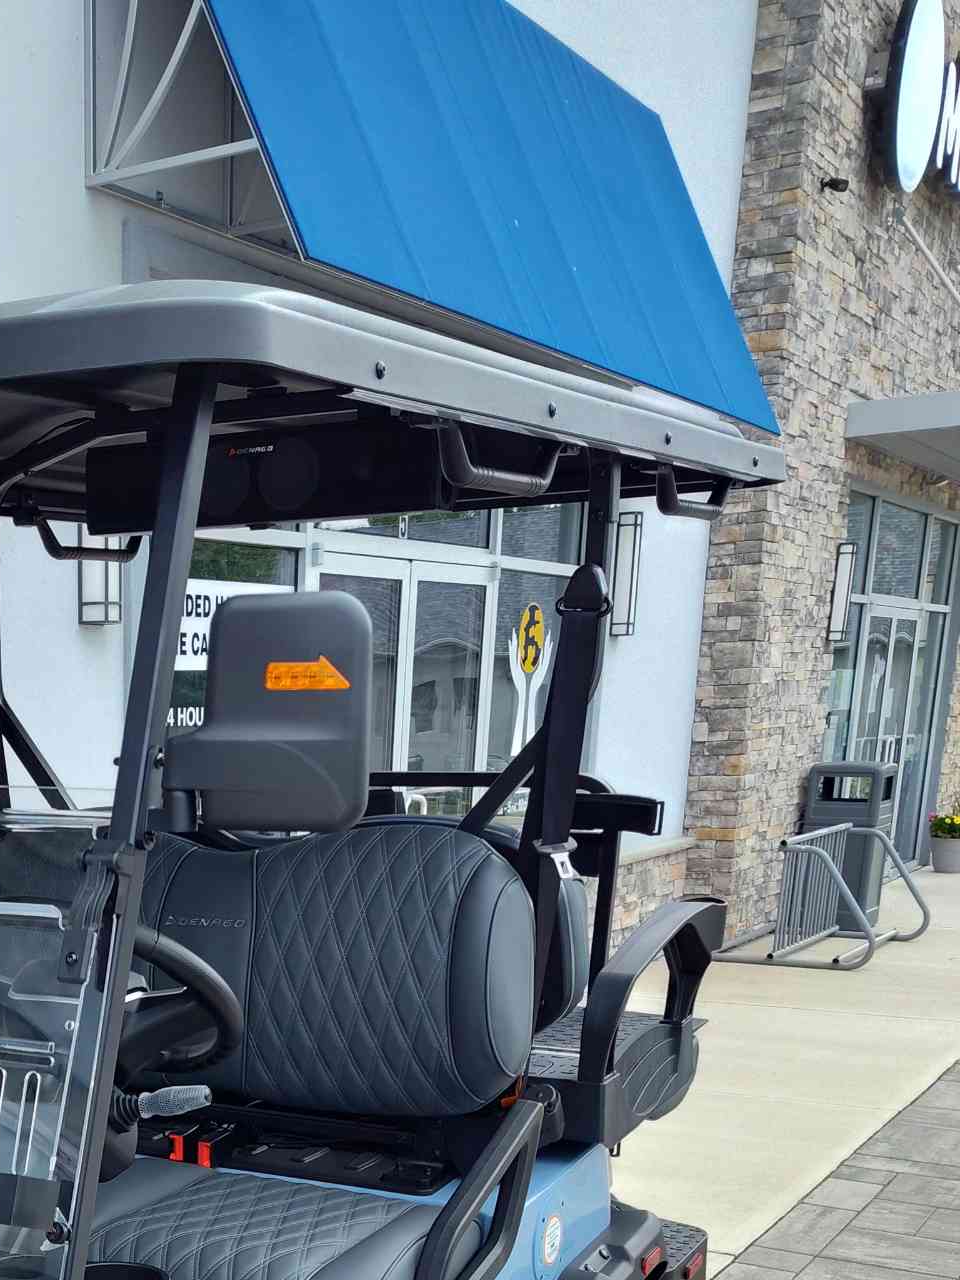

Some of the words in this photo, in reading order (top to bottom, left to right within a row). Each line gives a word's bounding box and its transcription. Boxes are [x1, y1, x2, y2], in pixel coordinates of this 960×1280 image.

[936, 61, 960, 190] M
[185, 594, 211, 618] DED
[179, 632, 187, 656] E
[191, 632, 208, 656] CA
[166, 706, 175, 727] 4
[177, 706, 205, 727] HOU
[178, 918, 246, 928] DENAGO
